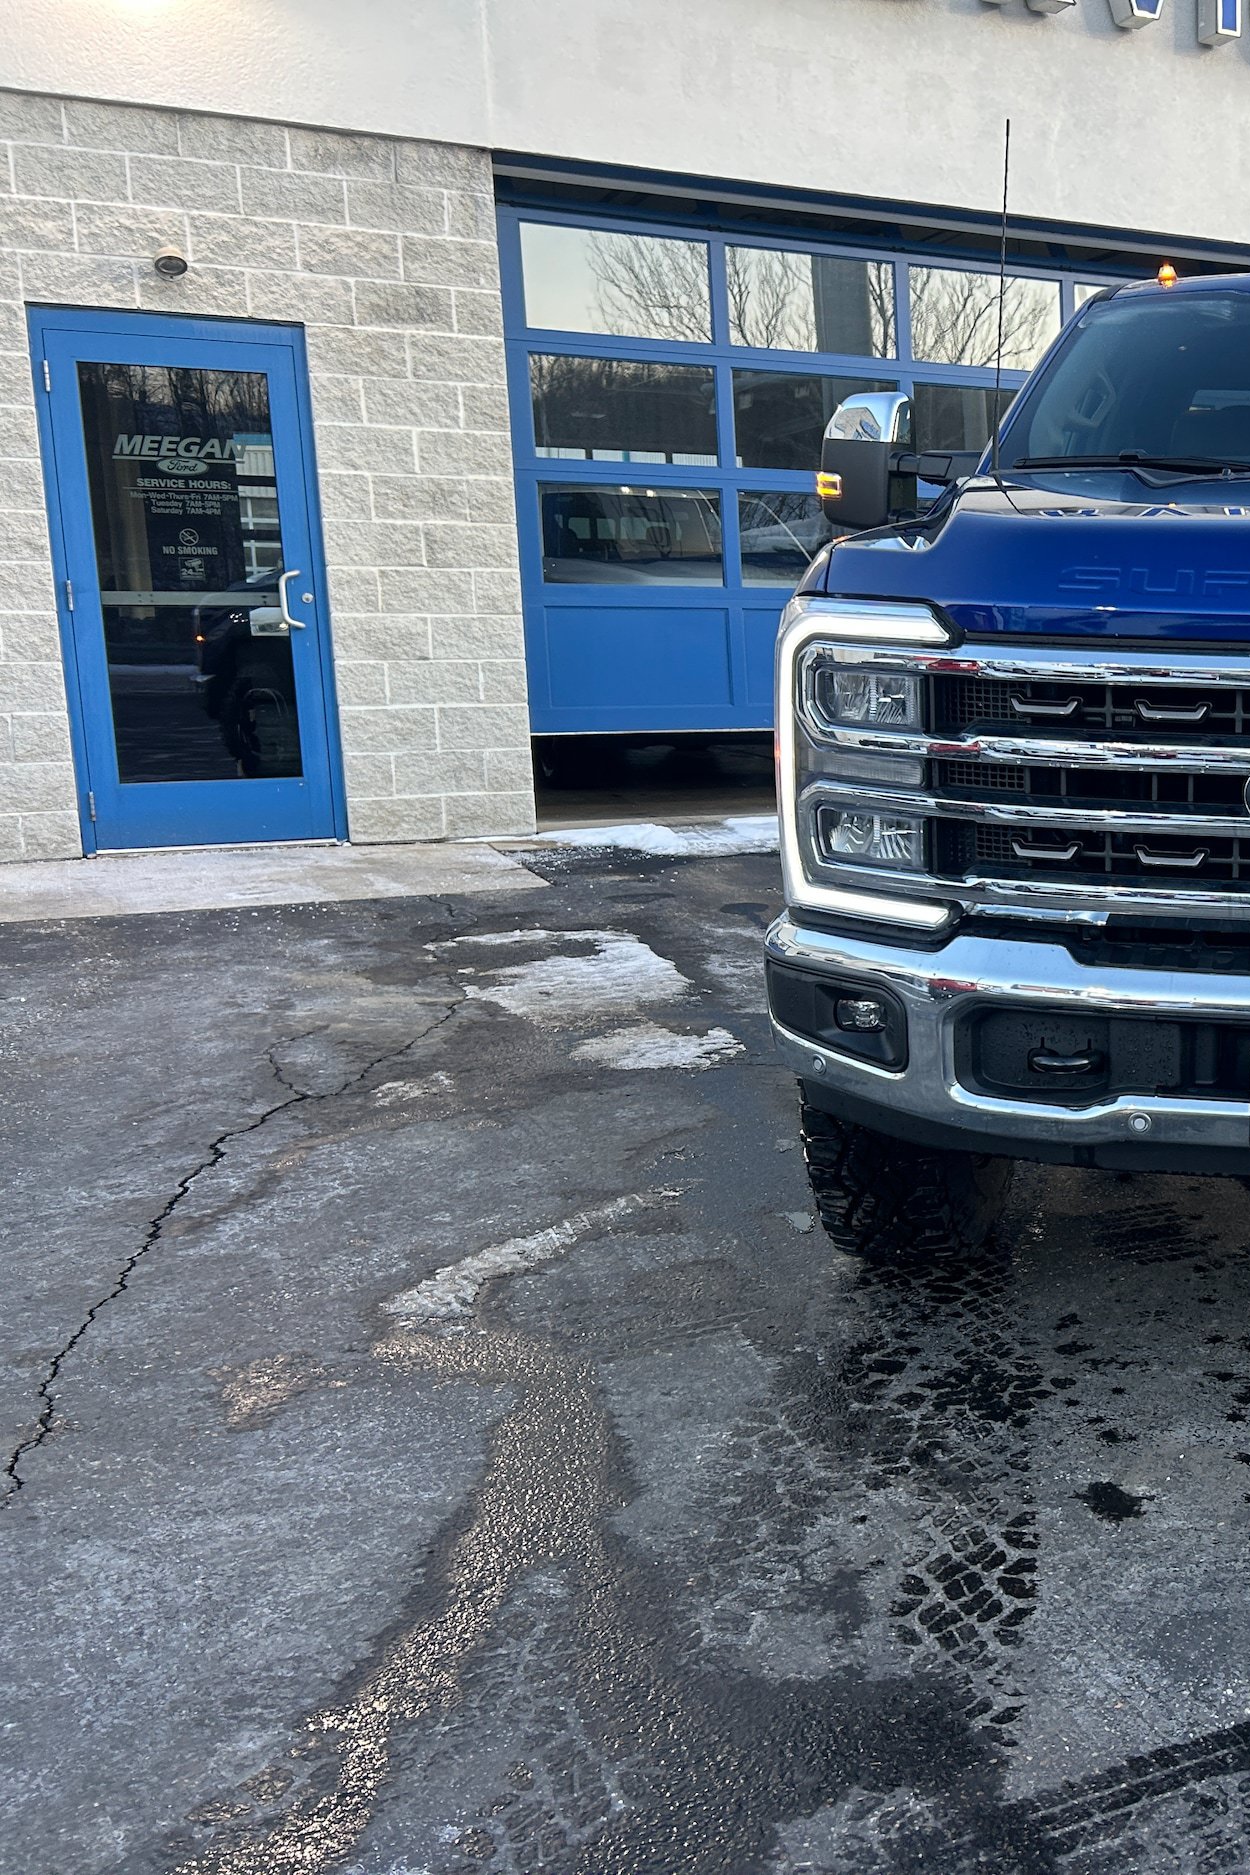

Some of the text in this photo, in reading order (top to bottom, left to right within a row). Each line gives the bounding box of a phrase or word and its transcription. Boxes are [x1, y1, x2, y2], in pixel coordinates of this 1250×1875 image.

[113, 433, 246, 458] MEEGAN
[167, 460, 198, 472] Ford
[137, 478, 232, 490] SERVICE HOURS:
[152, 499, 183, 507] Tuesday
[151, 507, 183, 515] Saturday
[162, 546, 219, 556] NO SMOKING
